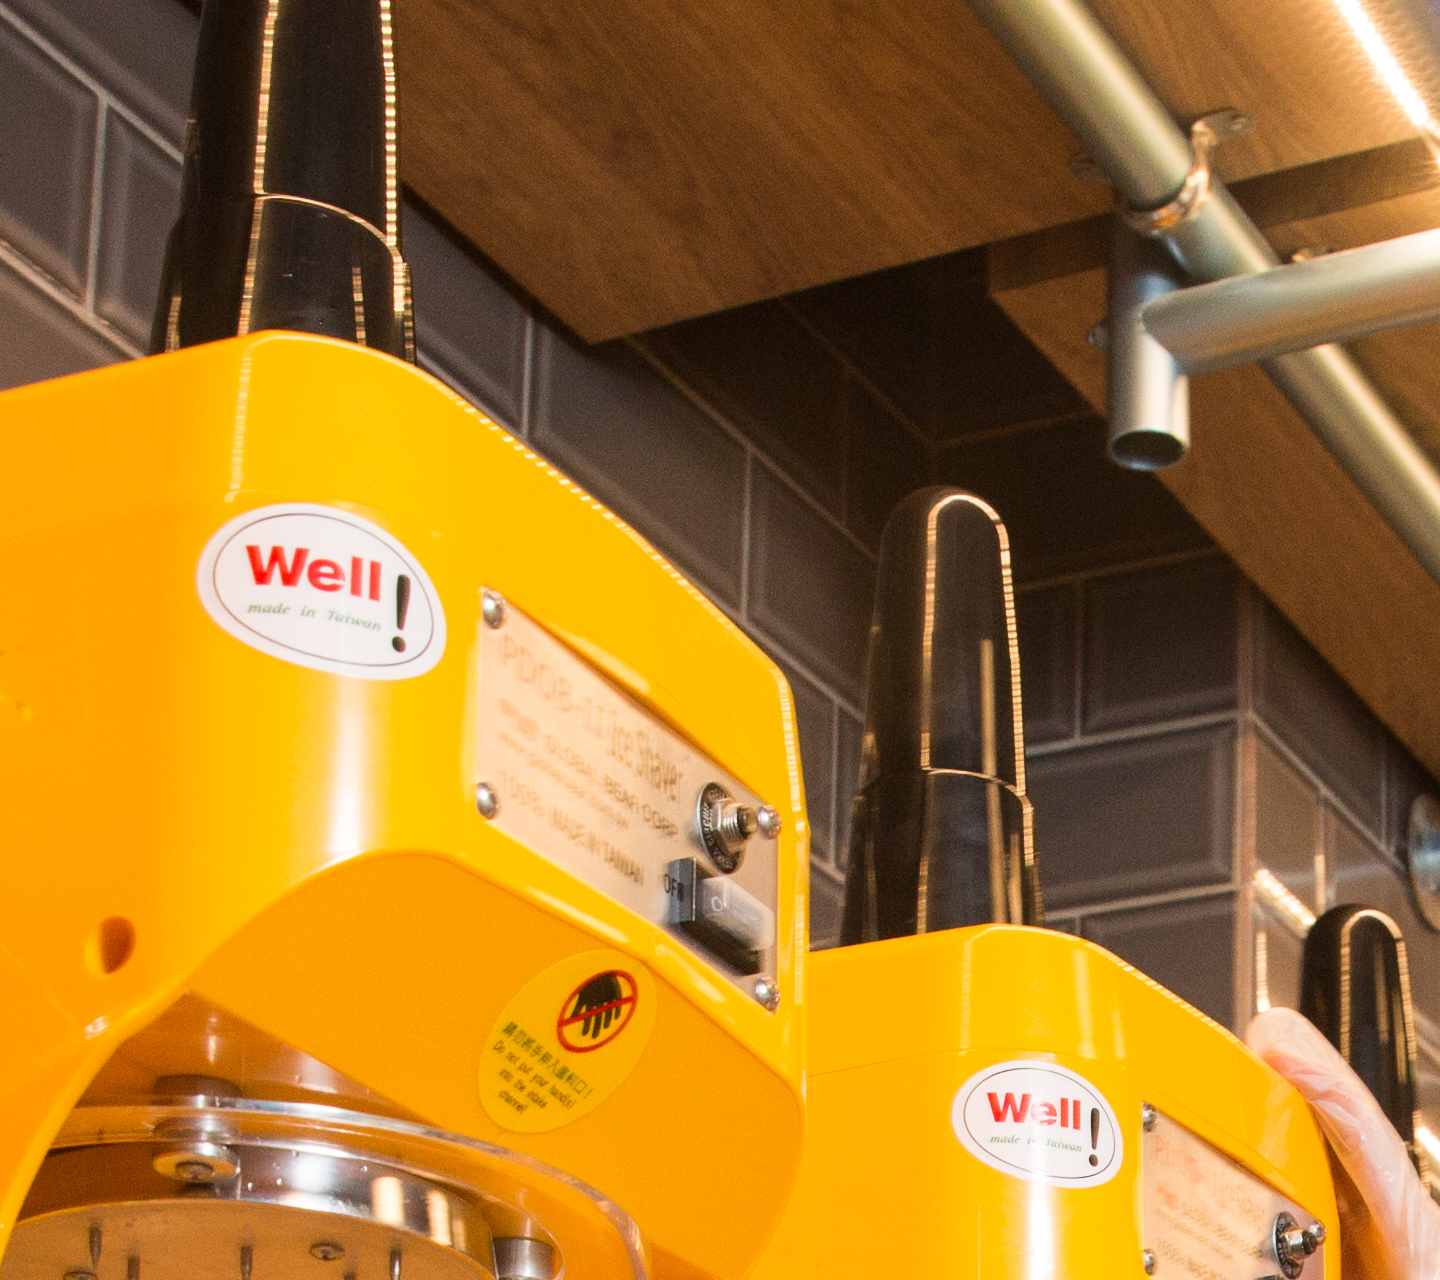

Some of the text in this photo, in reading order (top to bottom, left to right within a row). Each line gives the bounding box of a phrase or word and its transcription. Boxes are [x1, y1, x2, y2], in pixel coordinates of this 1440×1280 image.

[247, 602, 382, 632] made in Taiwan
[605, 776, 639, 809] BEAR
[990, 1134, 1021, 1144] made
[1046, 1138, 1082, 1153] Taiwan
